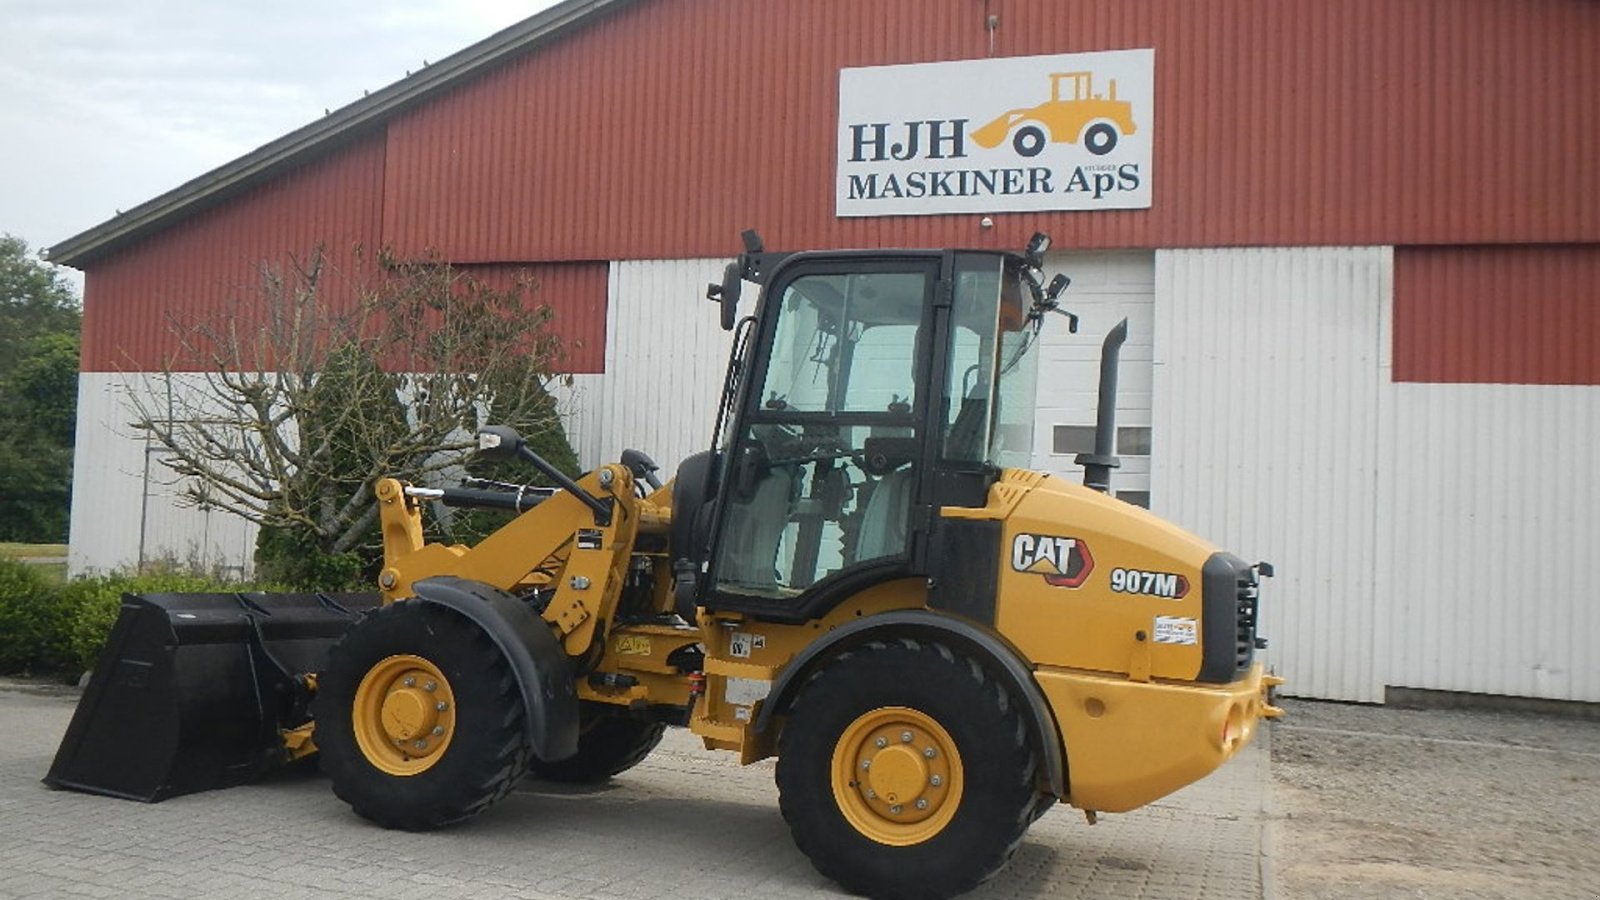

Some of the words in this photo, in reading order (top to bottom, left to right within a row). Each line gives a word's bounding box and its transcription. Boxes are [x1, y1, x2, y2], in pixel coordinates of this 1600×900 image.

[848, 119, 969, 162] HJH
[847, 168, 1054, 200] MASKINER
[1064, 163, 1140, 199] ApS
[1013, 534, 1076, 574] CAT
[1111, 568, 1176, 597] 907M
